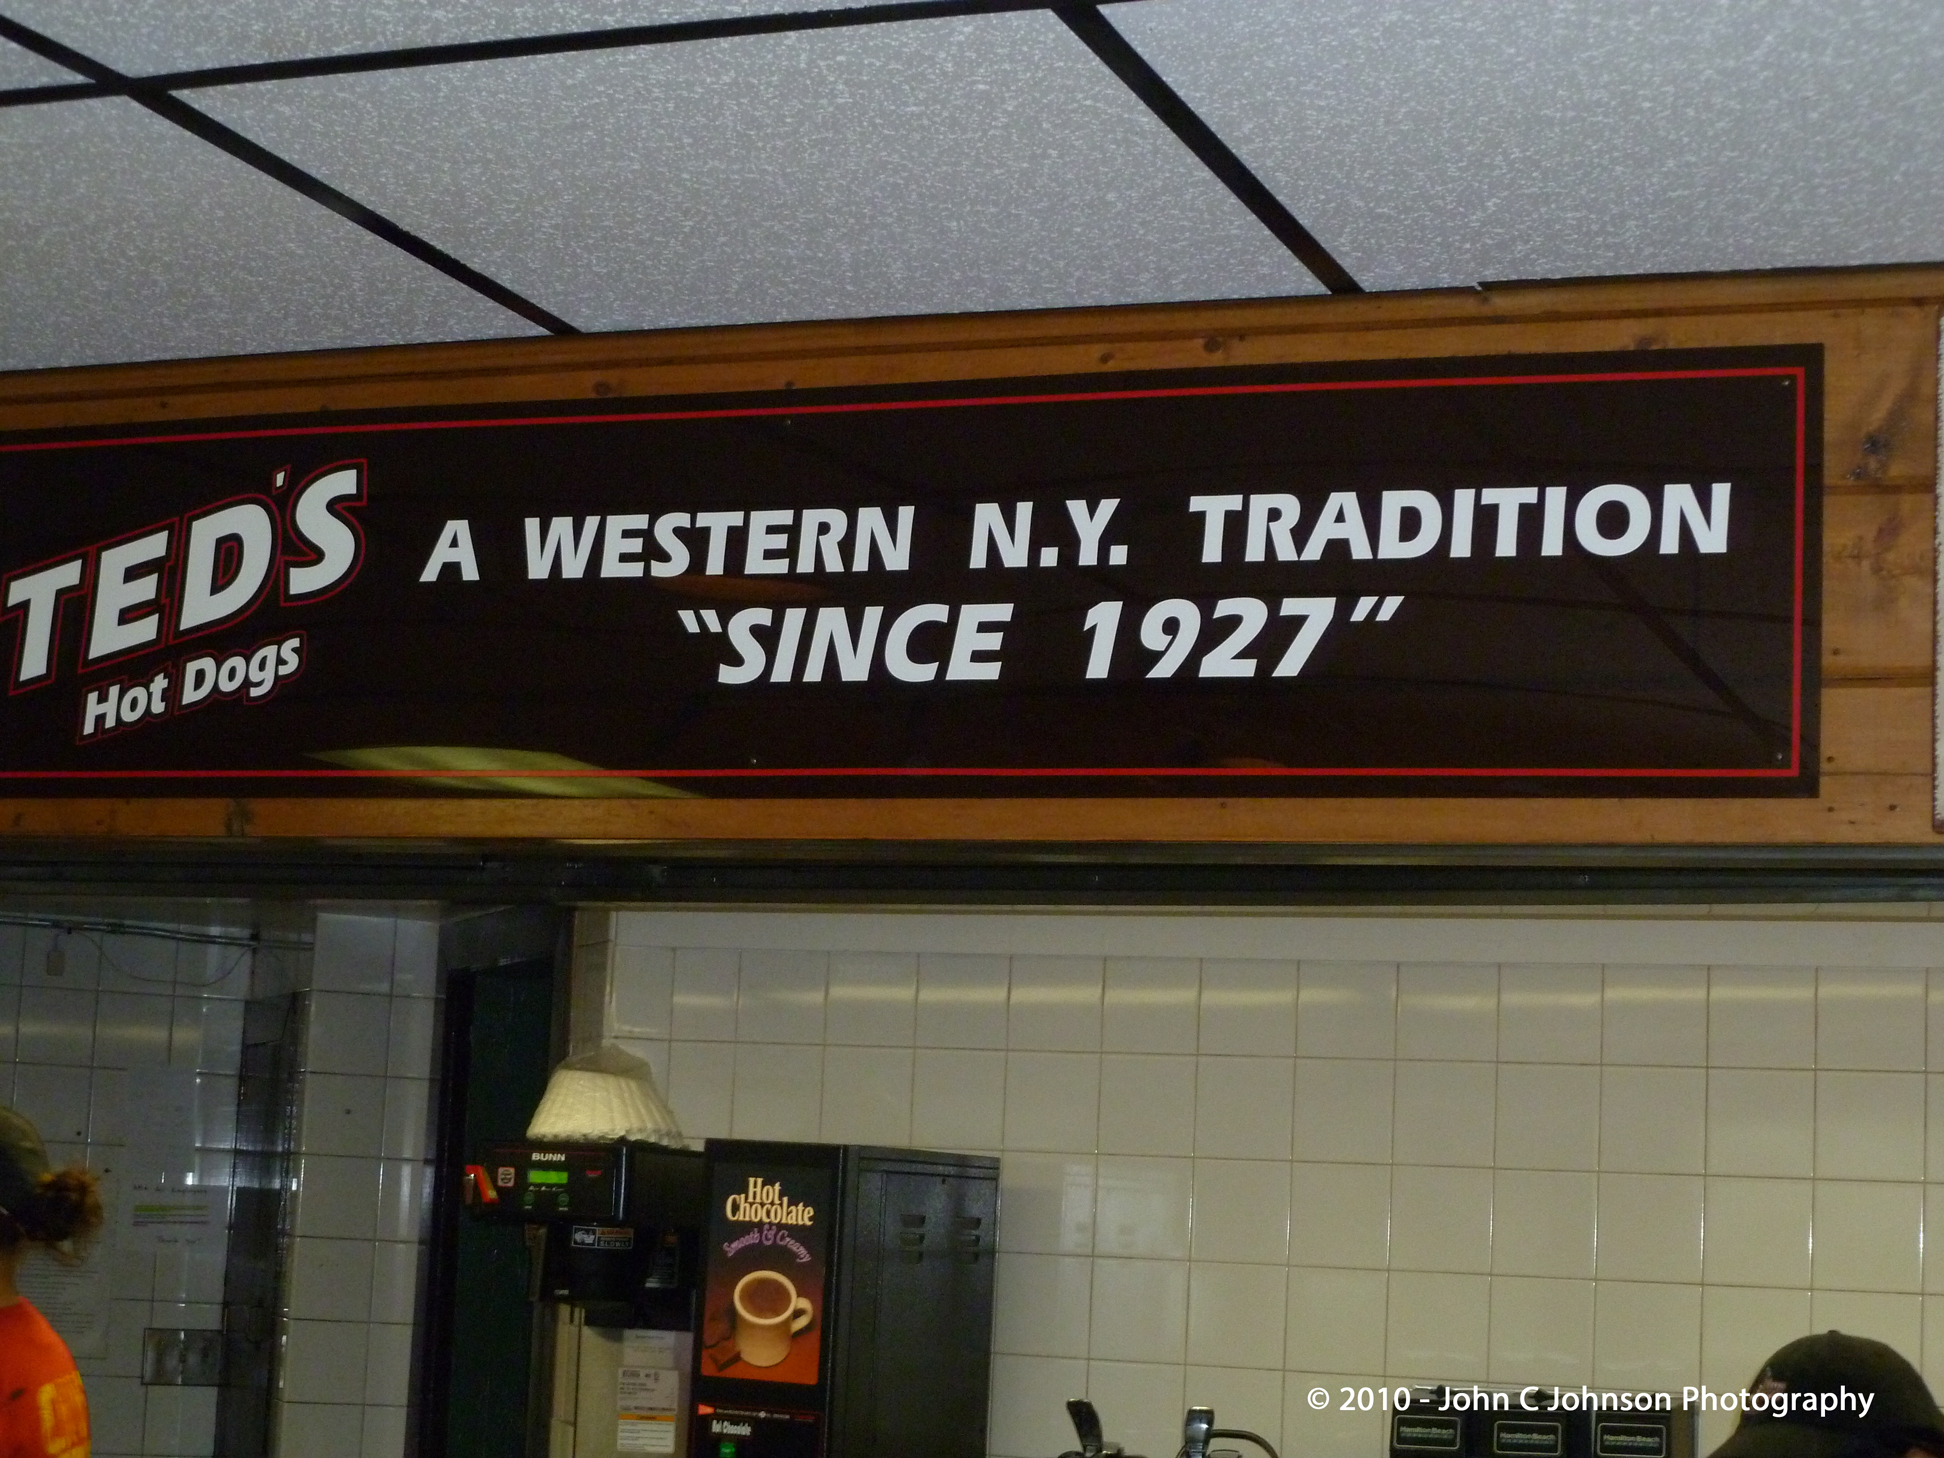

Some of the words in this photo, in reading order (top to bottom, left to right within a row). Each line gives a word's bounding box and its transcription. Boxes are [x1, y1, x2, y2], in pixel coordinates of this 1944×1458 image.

[419, 519, 480, 582] A
[524, 505, 915, 580] WESTERN
[969, 498, 1129, 569] N.Y.
[1188, 482, 1732, 563] TRADITION
[7, 469, 358, 683] TED'S
[677, 602, 1015, 685] "SINCE
[1083, 595, 1405, 679] 1927"
[81, 676, 169, 736] Hot
[180, 636, 301, 707] Dogs
[531, 1152, 566, 1161] BUNN
[725, 1194, 815, 1226] Chocolate
[747, 1177, 782, 1204] Hot
[761, 1223, 777, 1246] &
[776, 1229, 812, 1263] Creamy
